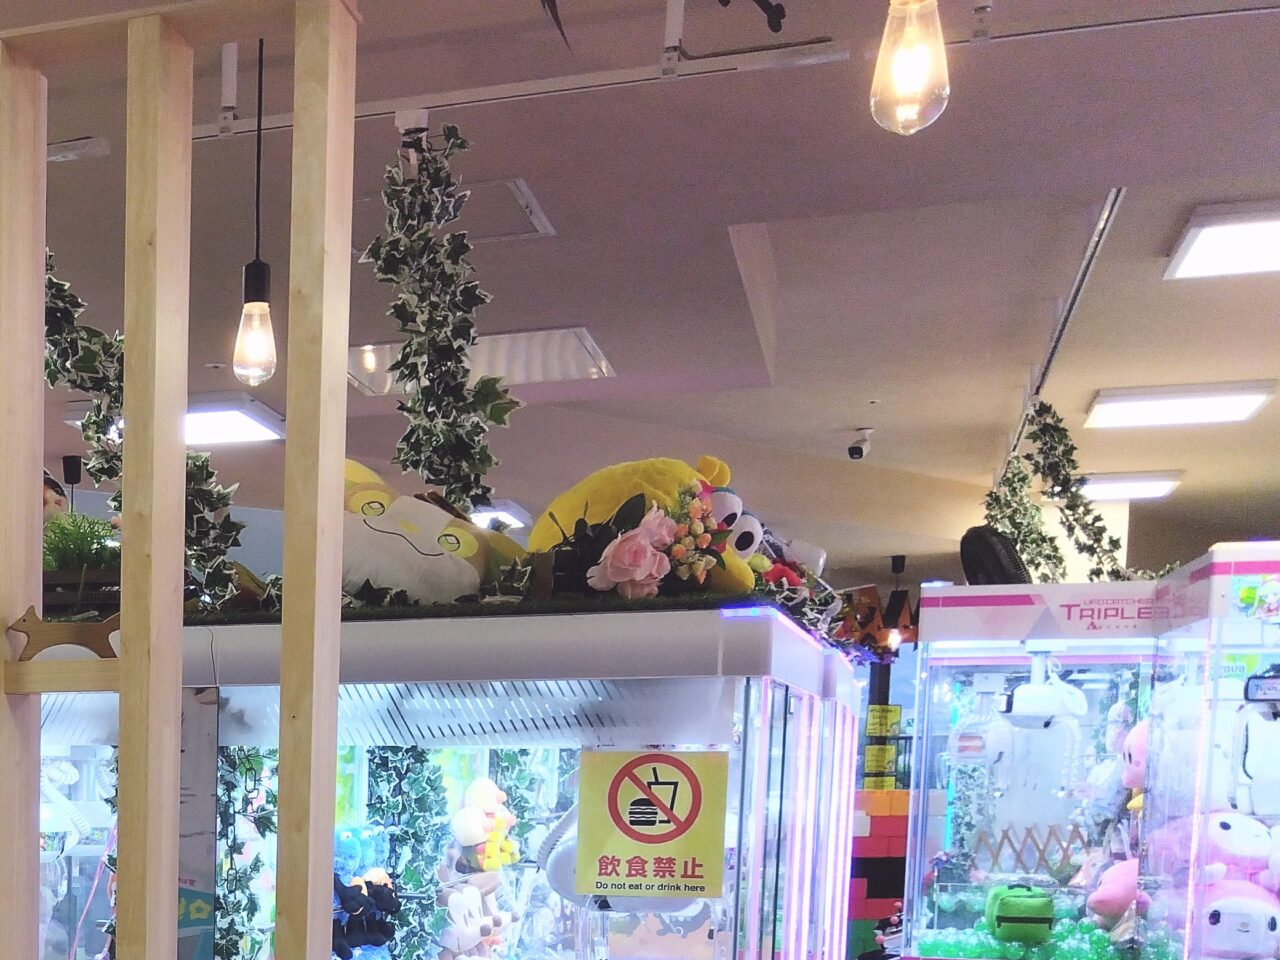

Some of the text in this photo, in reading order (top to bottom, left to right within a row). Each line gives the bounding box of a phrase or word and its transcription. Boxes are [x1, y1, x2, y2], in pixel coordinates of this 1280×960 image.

[1060, 603, 1153, 621] TRIPLE
[597, 855, 704, 879] 飲食禁止
[595, 881, 608, 890] Do
[610, 882, 626, 890] not
[628, 883, 642, 891] eat
[657, 883, 681, 892] drink
[684, 884, 705, 892] here
